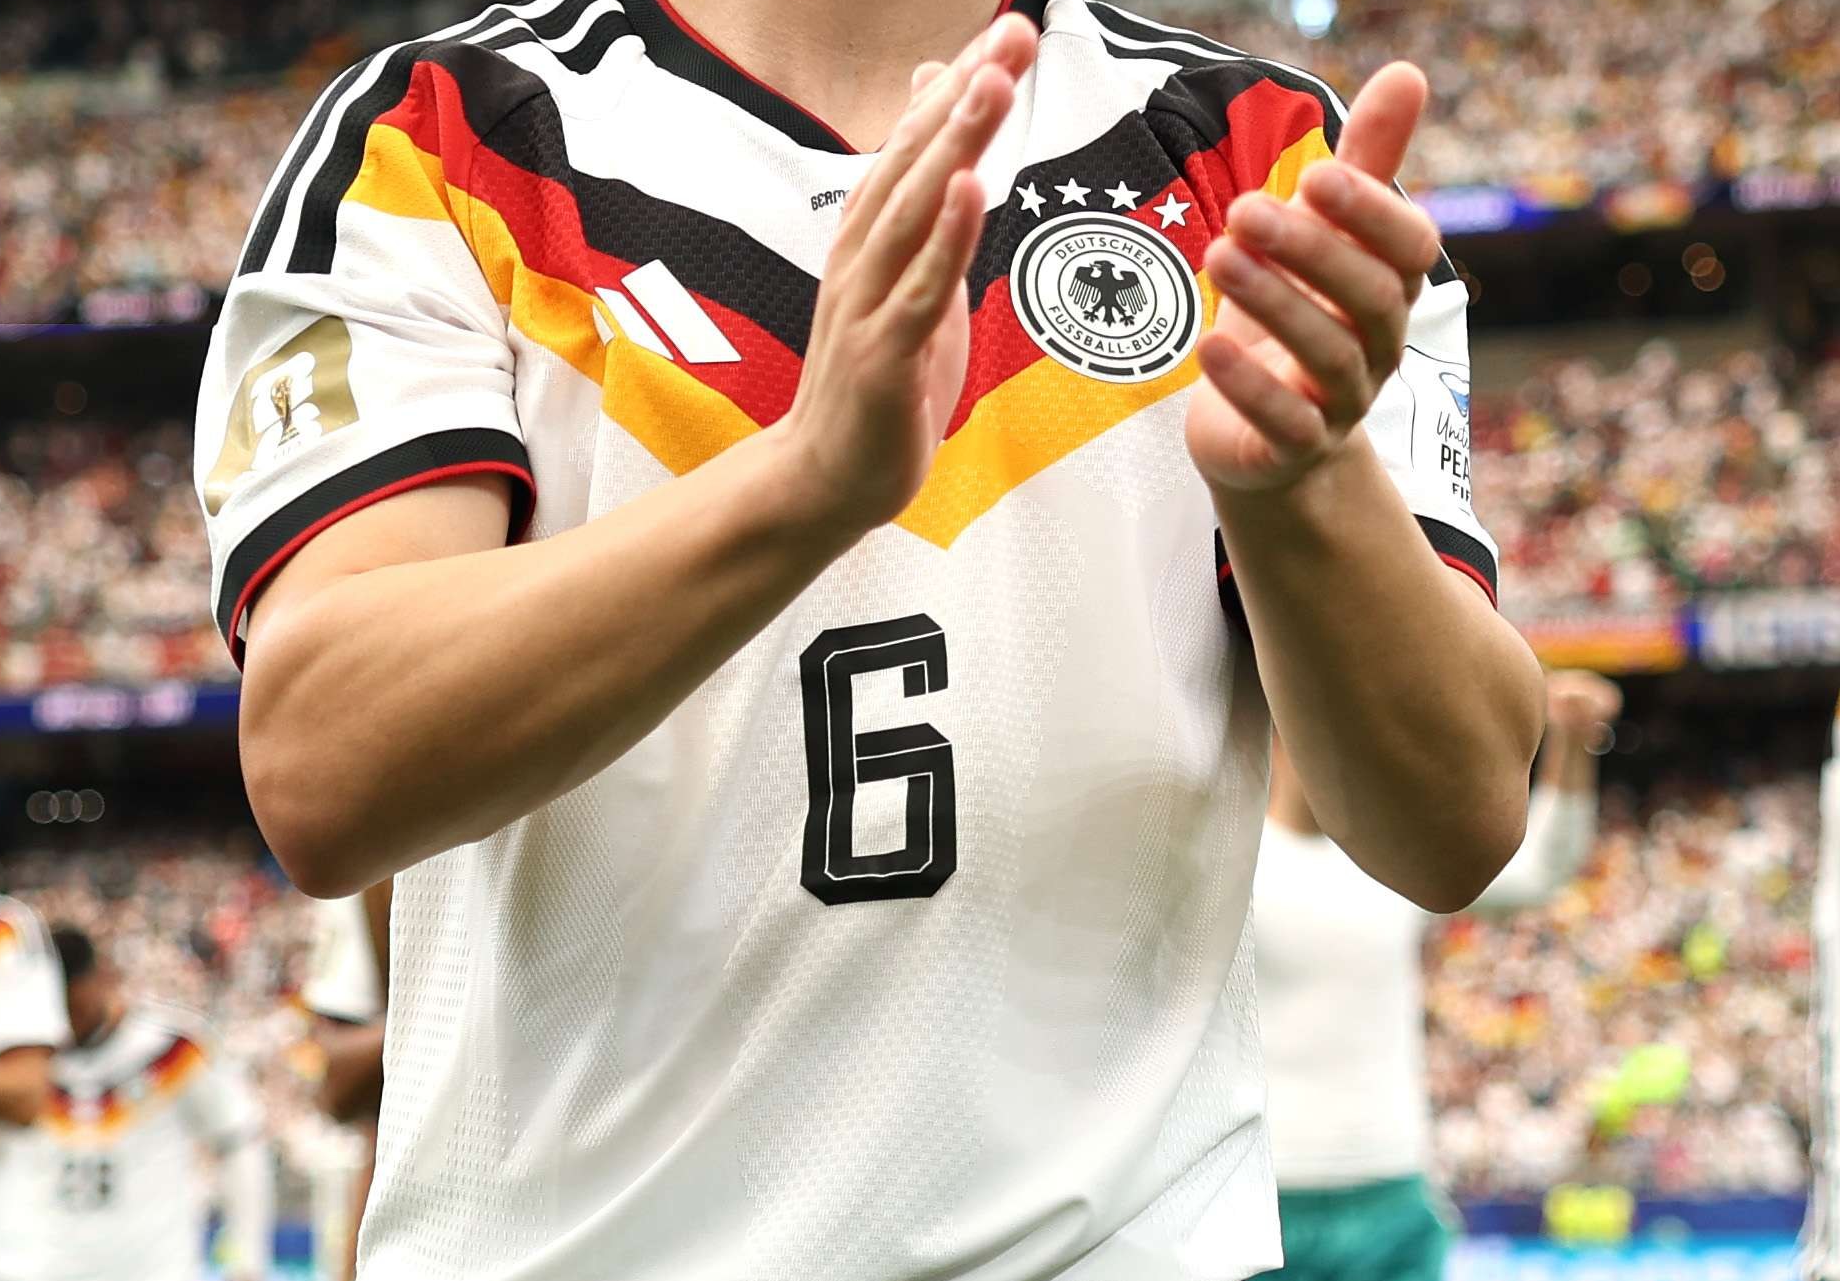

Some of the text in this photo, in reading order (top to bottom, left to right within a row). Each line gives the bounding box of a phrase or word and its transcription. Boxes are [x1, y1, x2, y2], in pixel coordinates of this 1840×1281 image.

[811, 189, 850, 211] GERM
[1055, 237, 1154, 268] DEUTSCHER
[1048, 305, 1169, 354] FUSSBALL-BUND
[799, 612, 957, 906] 6
